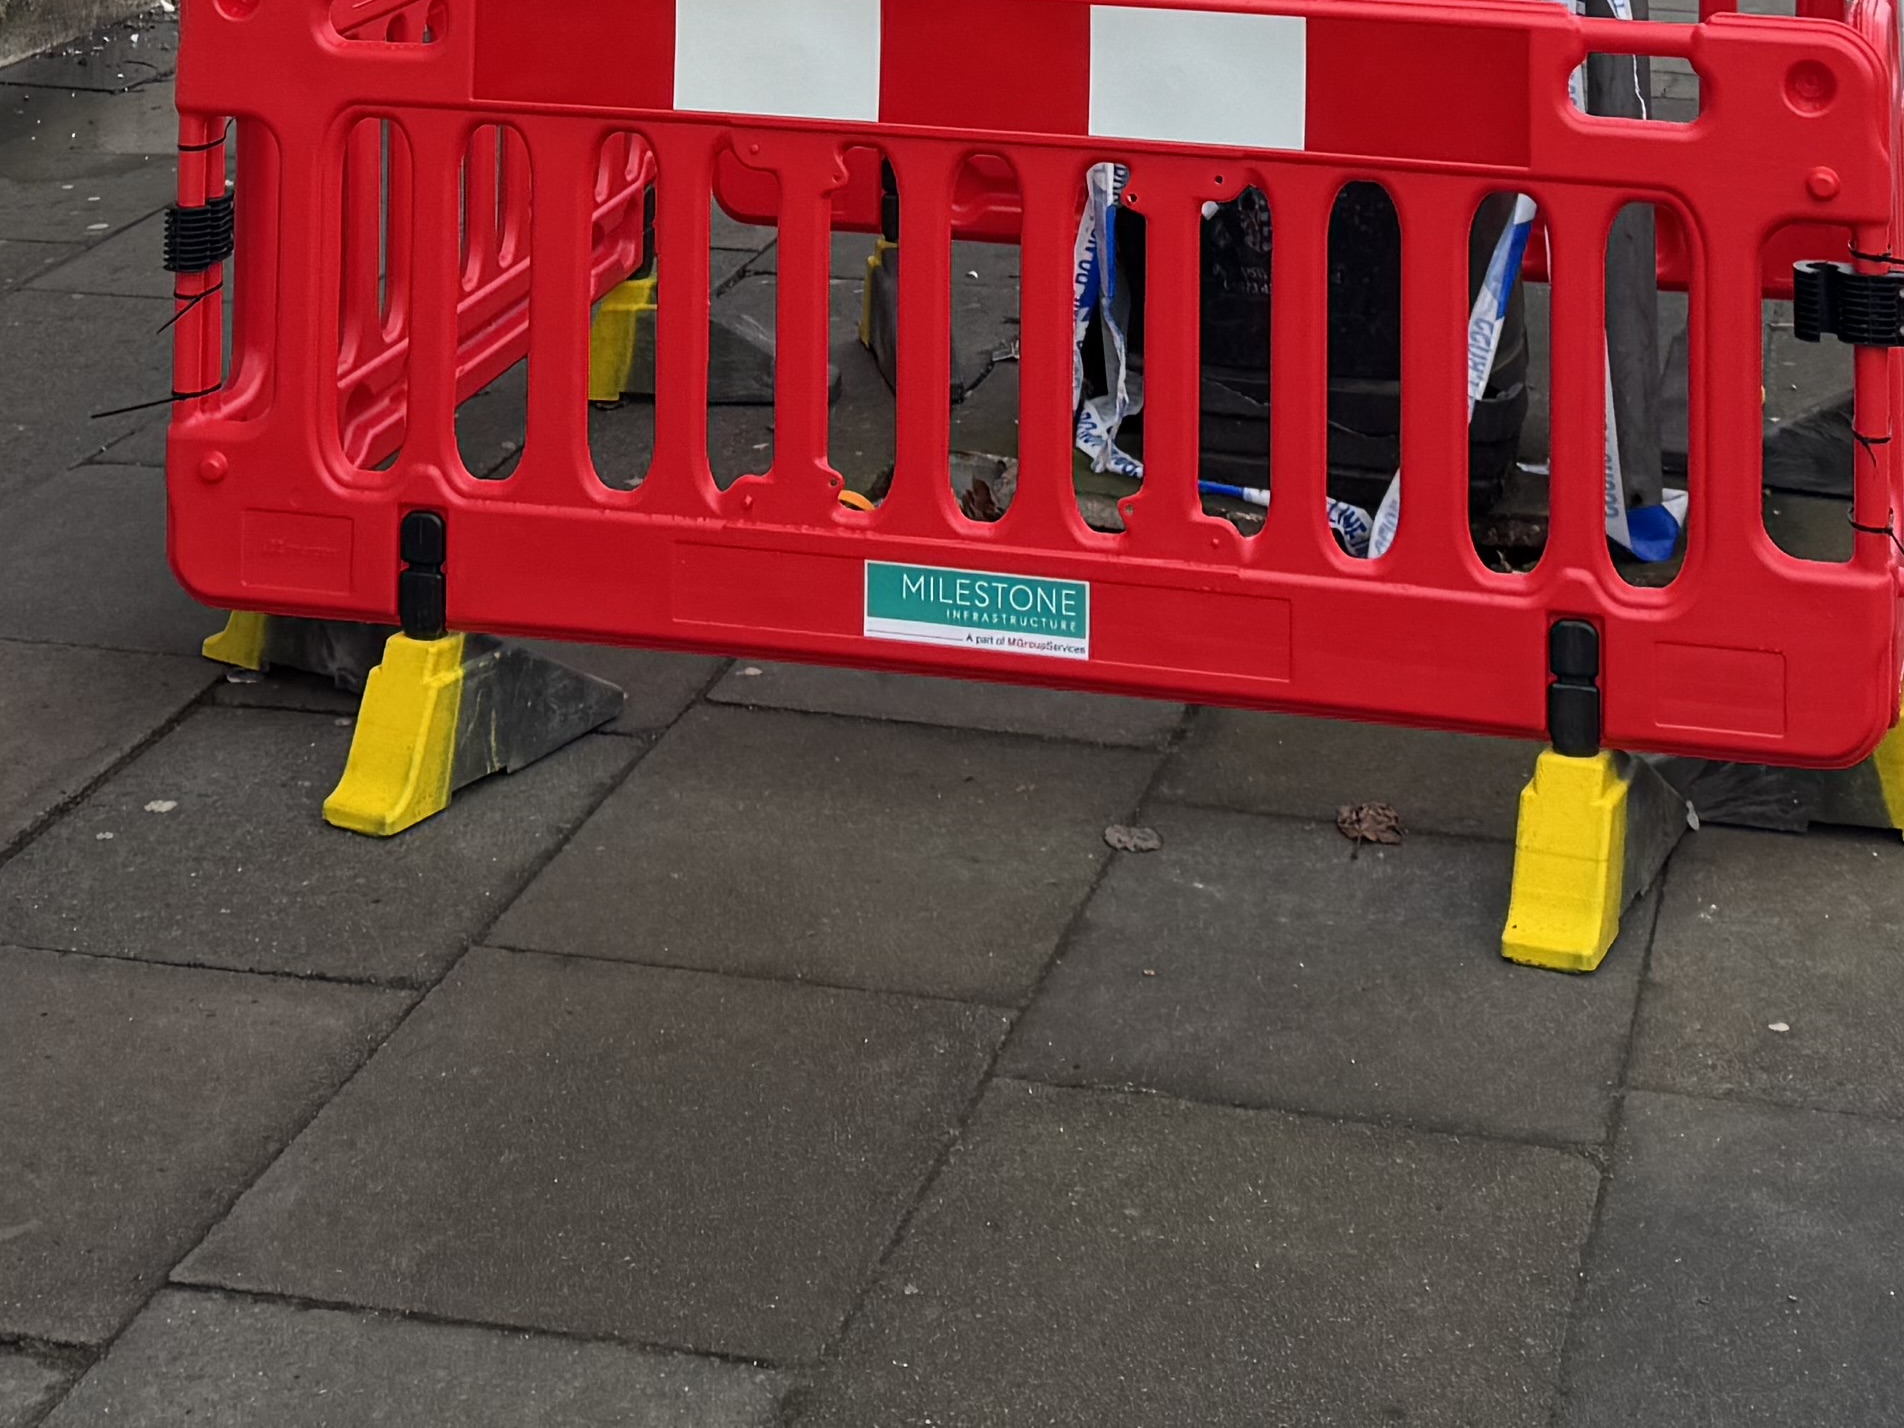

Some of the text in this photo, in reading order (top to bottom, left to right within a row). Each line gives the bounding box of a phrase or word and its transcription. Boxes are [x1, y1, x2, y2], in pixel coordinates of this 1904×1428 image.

[901, 572, 1077, 616] MILESTONE
[946, 608, 1078, 633] INFRASTRUCTURE
[965, 632, 974, 643] A
[975, 633, 994, 648] part
[996, 634, 1006, 646] of
